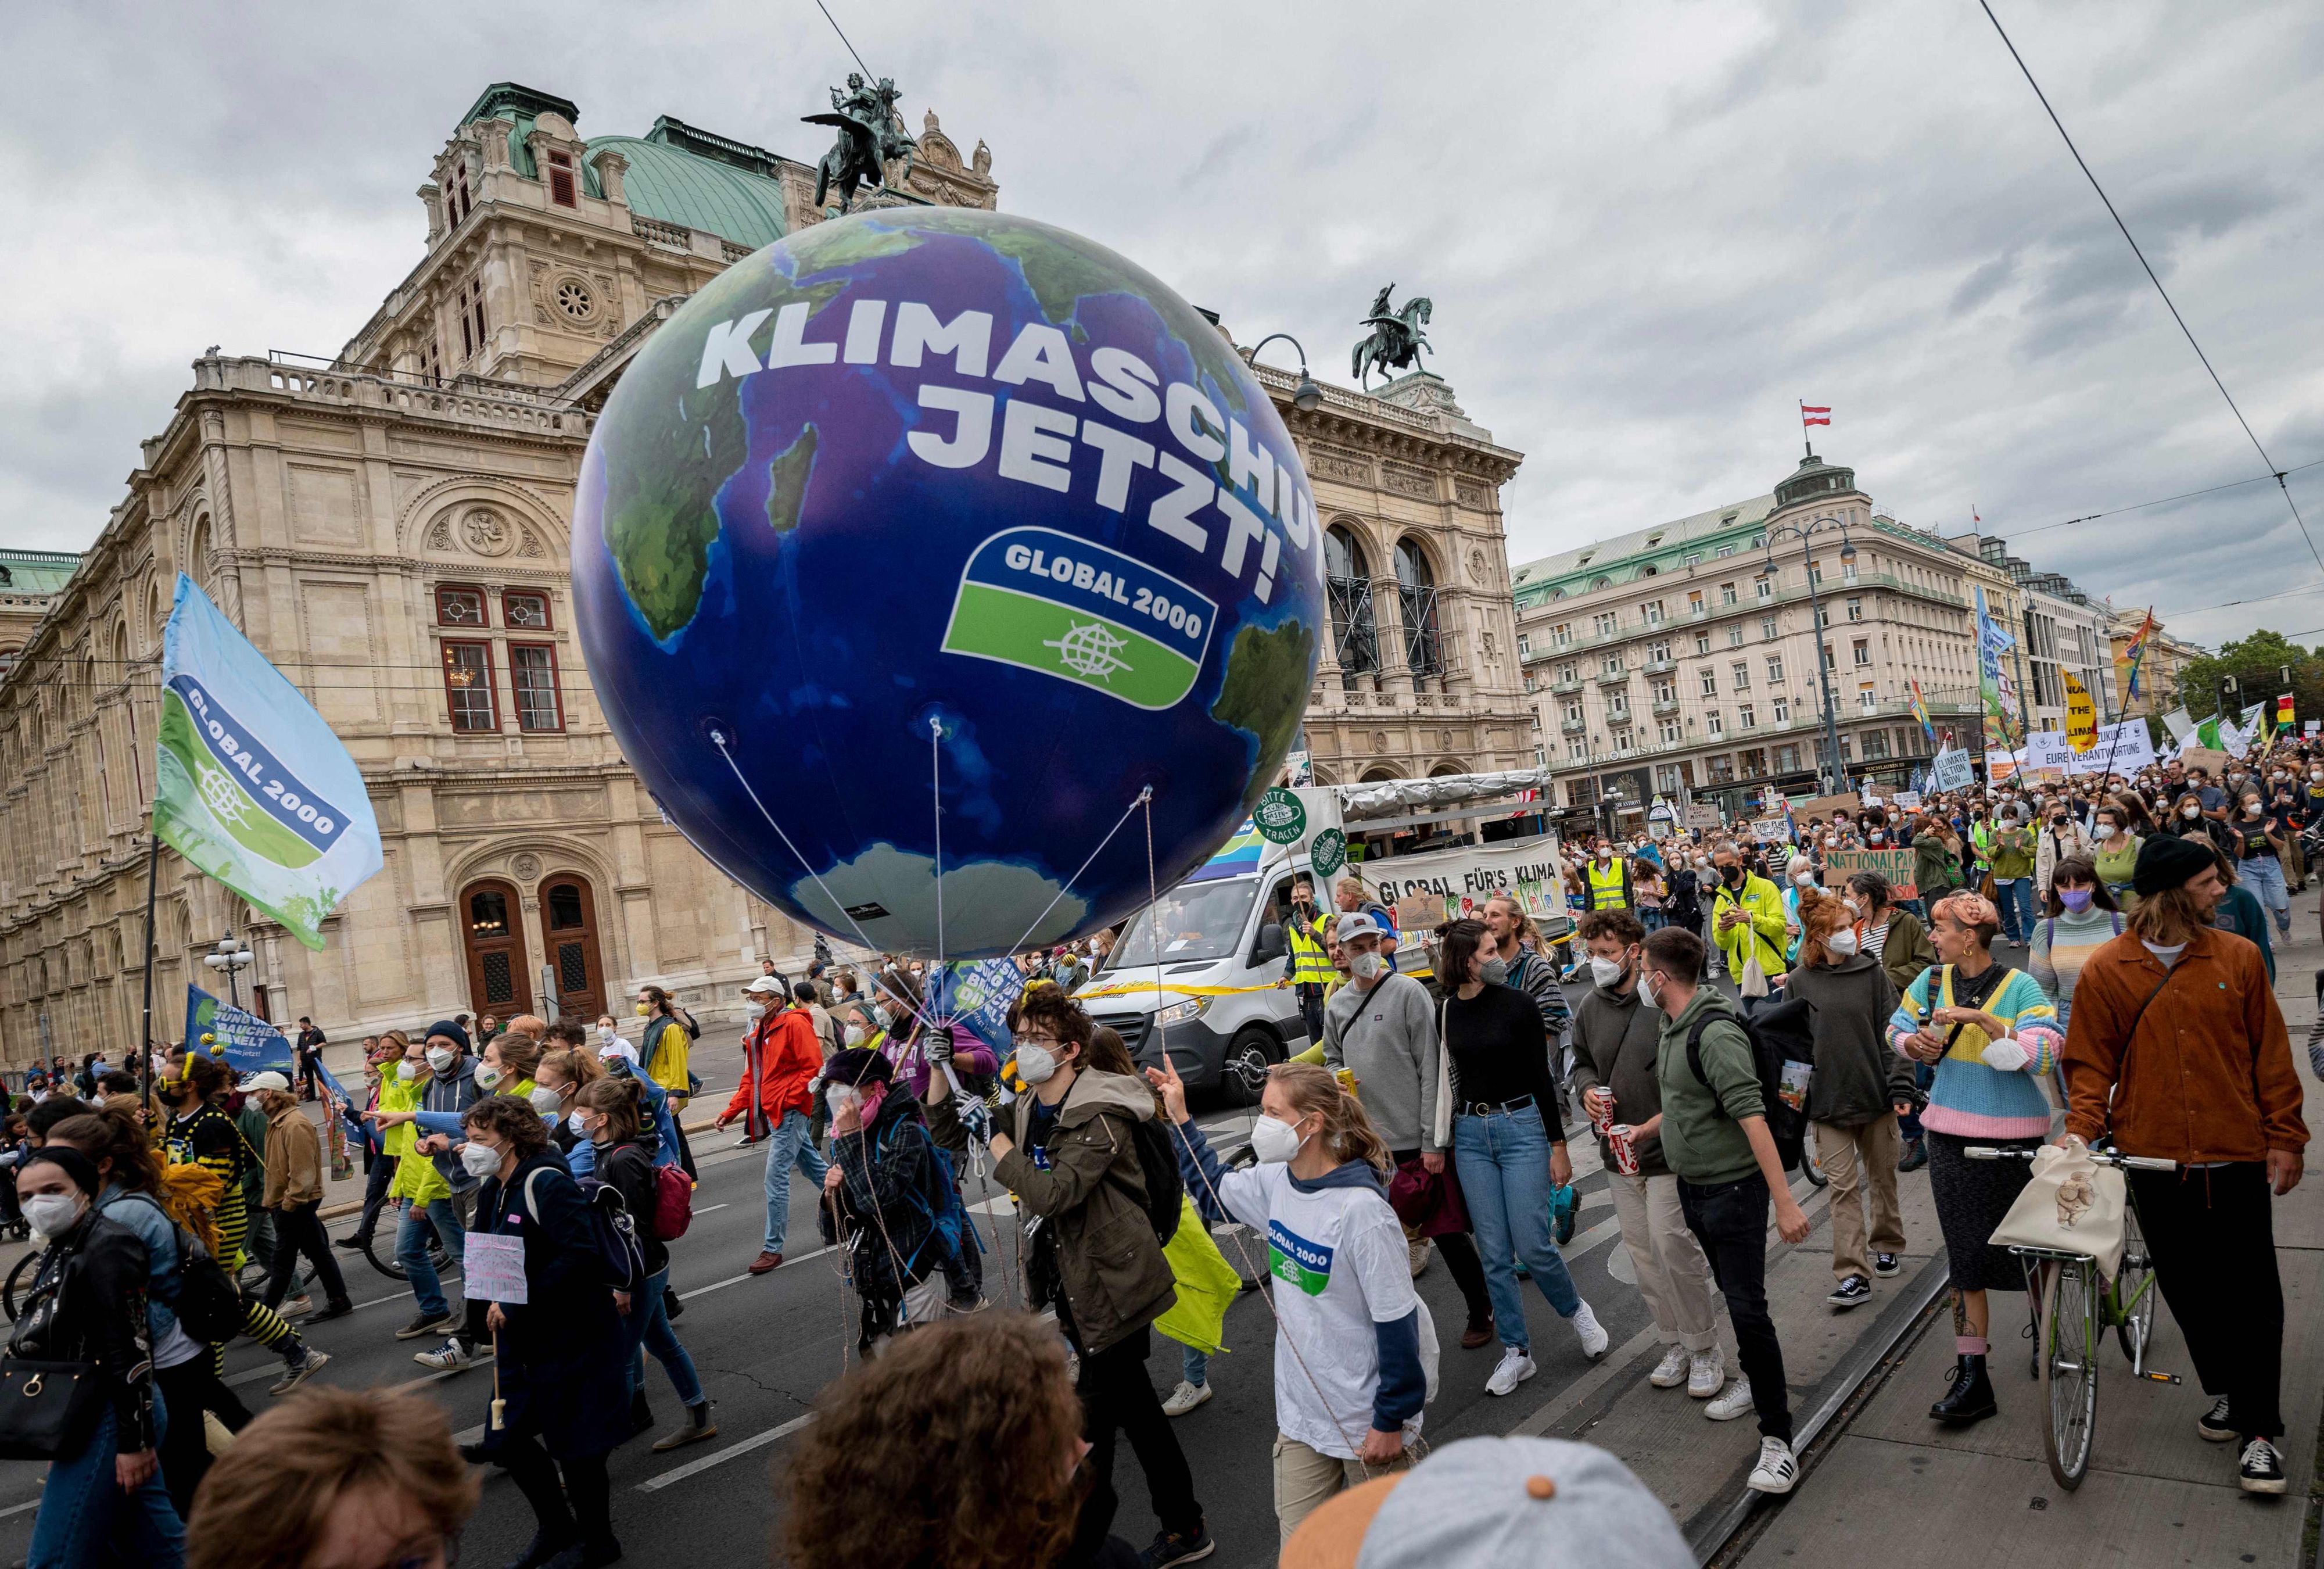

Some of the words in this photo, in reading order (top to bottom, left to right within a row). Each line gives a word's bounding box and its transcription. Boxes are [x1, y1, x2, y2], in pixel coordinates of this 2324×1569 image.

[907, 385, 1281, 604] JETZT!
[1005, 544, 1132, 607] GLOBAL
[1131, 587, 1202, 639] 2000
[2069, 705, 2090, 715] THE
[2067, 726, 2092, 737] LIMA
[1569, 753, 1610, 767] HOTEL
[1620, 742, 1674, 758] BRISTOL
[2046, 752, 2068, 764] EURE
[2070, 742, 2140, 762] VERANTWORTUNG
[189, 688, 262, 784] GLOBAL
[262, 779, 335, 835] 2000
[1865, 764, 1899, 772] TUCHLAUBEN
[1937, 753, 1967, 769] CLIMATE
[1941, 763, 1966, 778] ACTION
[1943, 774, 1961, 787] NOW
[1261, 791, 1286, 806] BITTE
[1239, 823, 1253, 832] 00
[1266, 826, 1300, 841] TRAGEN
[1313, 833, 1327, 858] BITTE
[1328, 843, 1345, 872] TRAGEN
[1379, 876, 1455, 907] GLOBAL
[1464, 868, 1507, 893] FÜR'S
[1515, 862, 1556, 884] KLIMA
[213, 1011, 250, 1024] JUNG
[232, 1035, 267, 1048] WELT
[1268, 1226, 1294, 1253] GLOBAL
[1296, 1246, 1327, 1266] 2000
